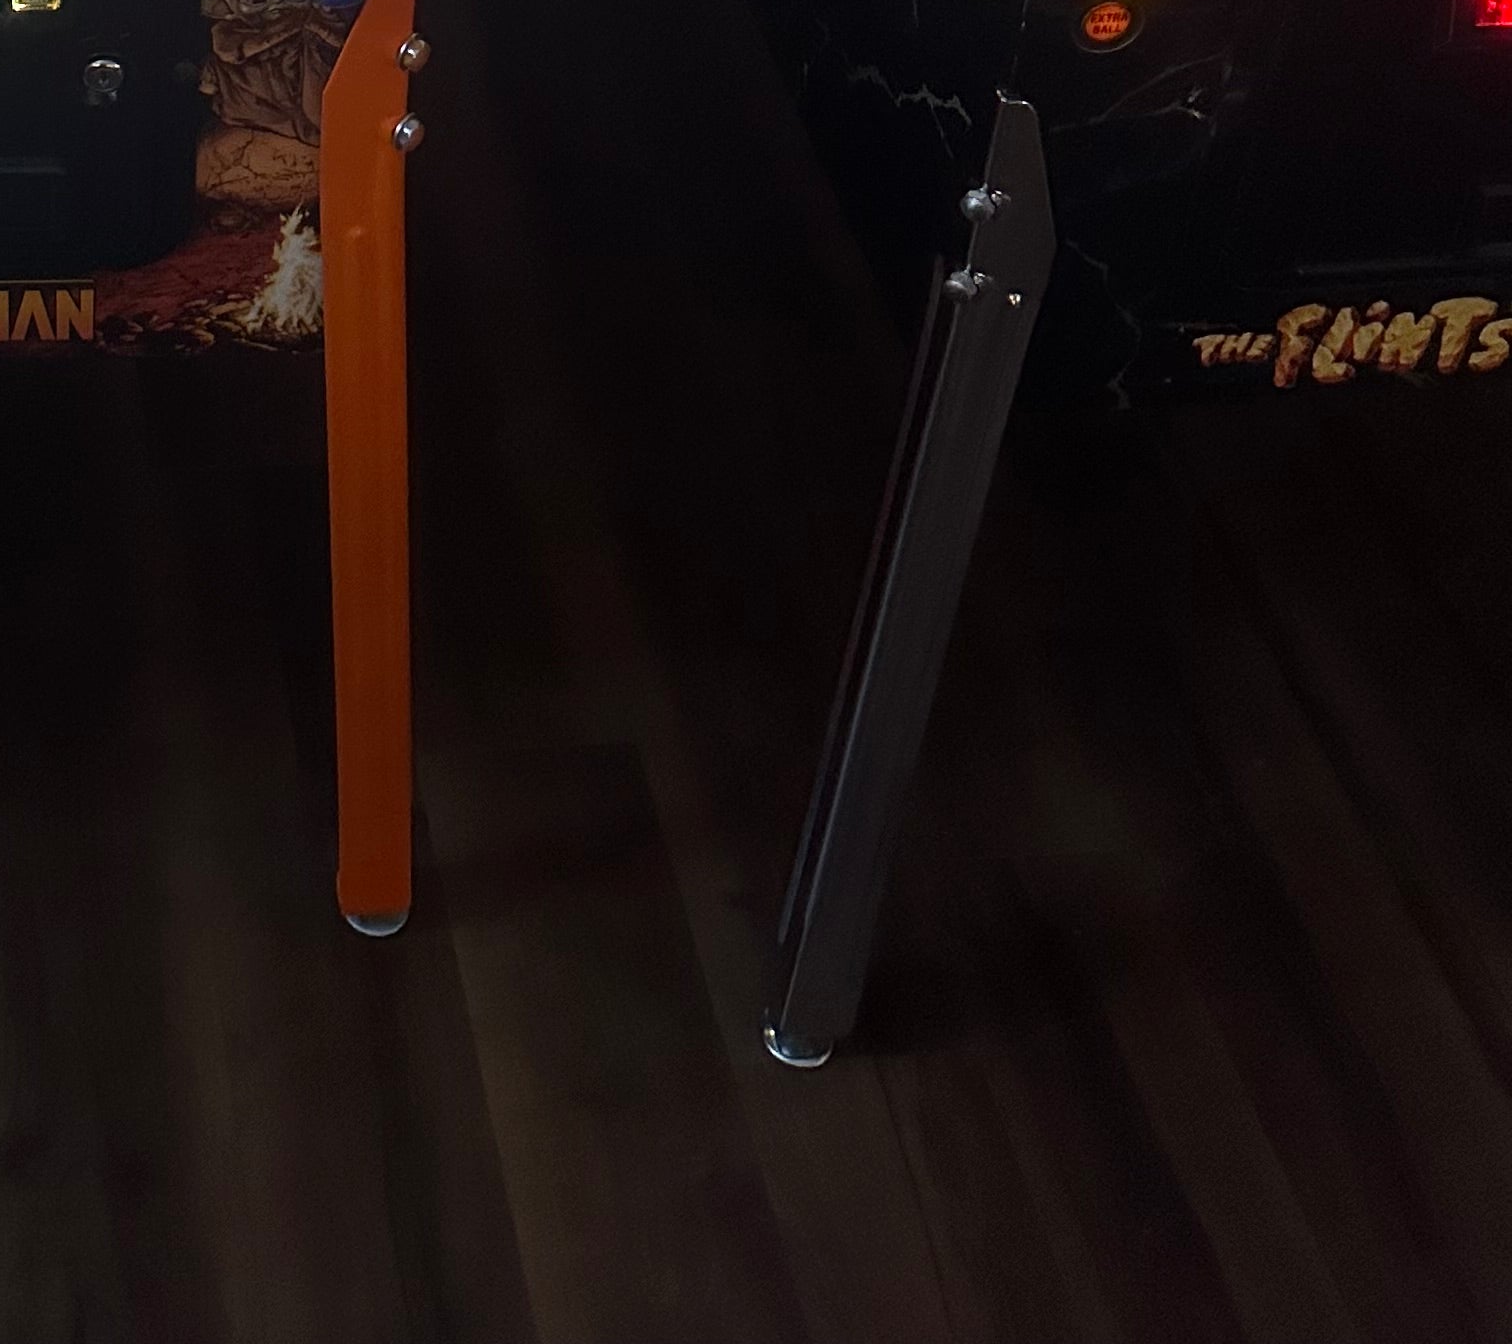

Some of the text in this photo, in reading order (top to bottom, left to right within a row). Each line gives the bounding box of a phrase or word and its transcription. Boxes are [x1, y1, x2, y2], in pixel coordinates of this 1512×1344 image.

[1090, 13, 1128, 23] EXTRA
[1092, 24, 1121, 34] BALL
[1194, 331, 1272, 366] THE
